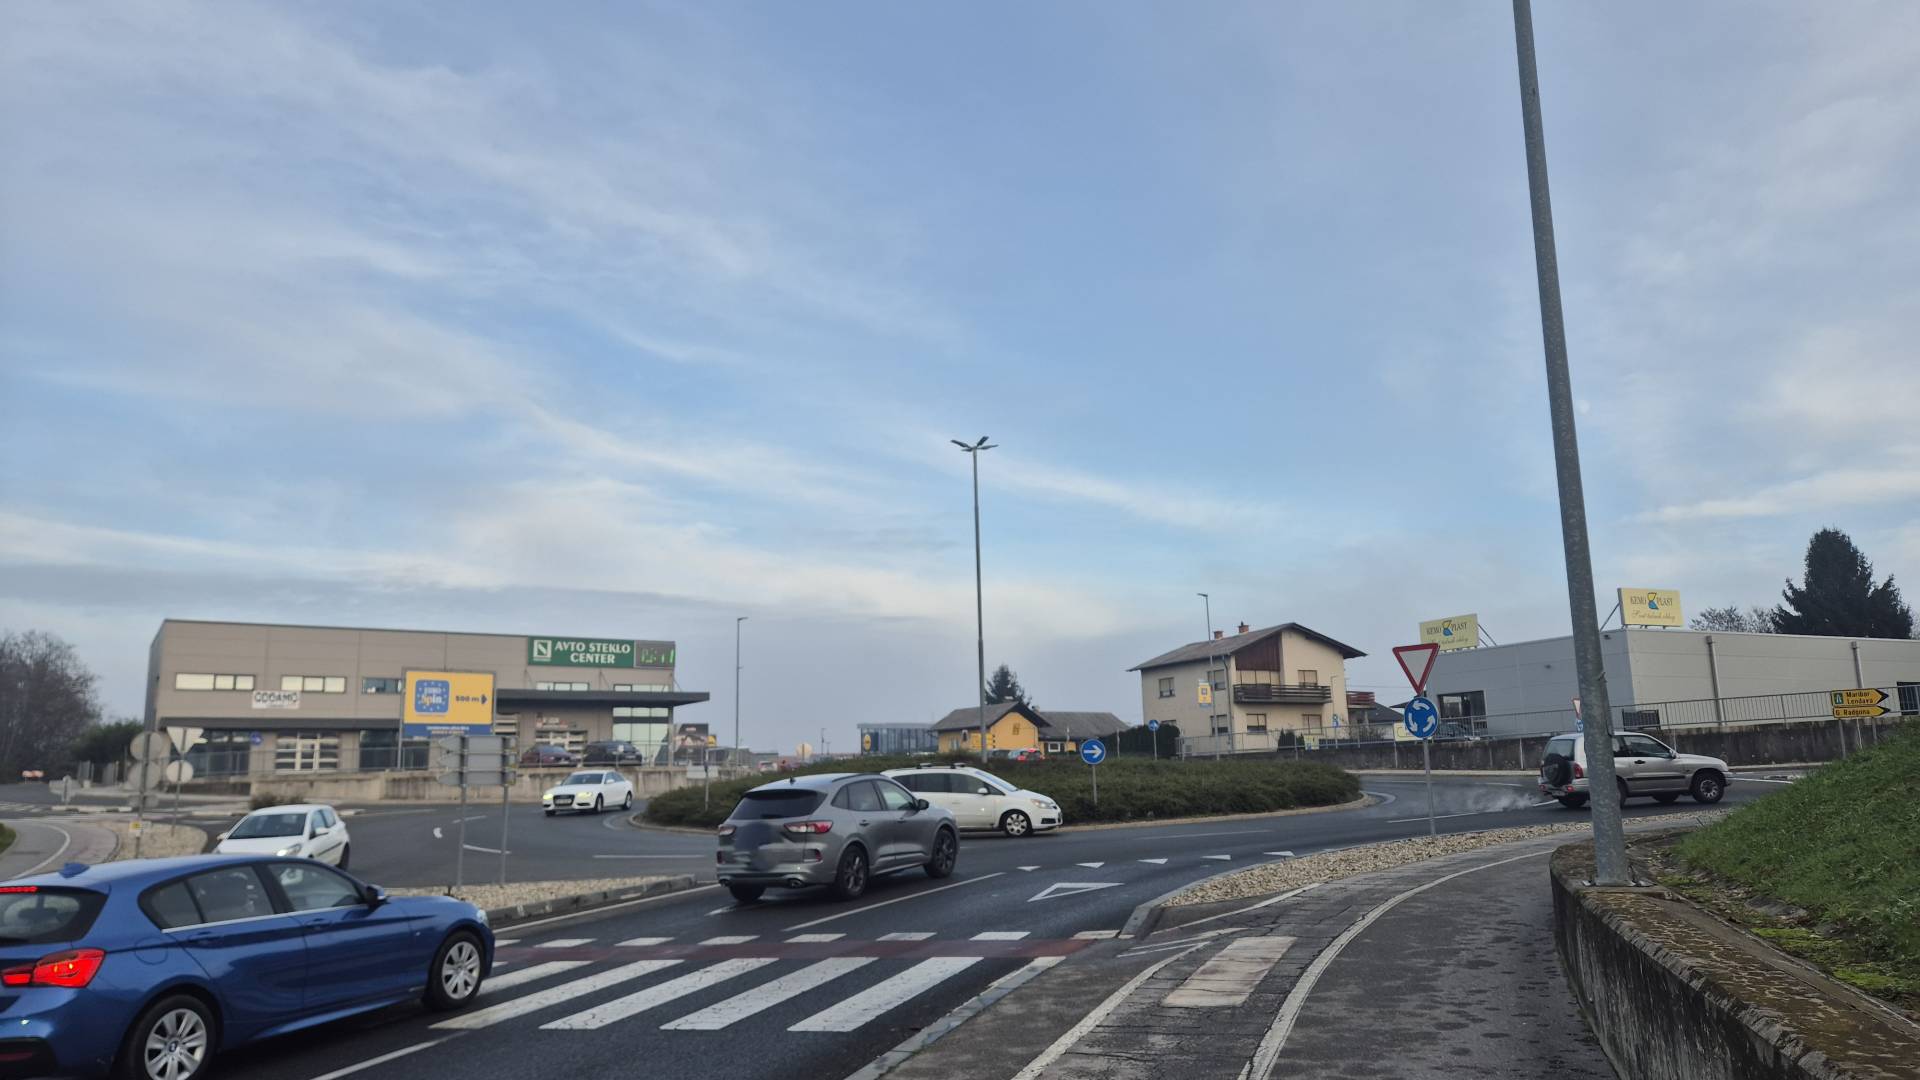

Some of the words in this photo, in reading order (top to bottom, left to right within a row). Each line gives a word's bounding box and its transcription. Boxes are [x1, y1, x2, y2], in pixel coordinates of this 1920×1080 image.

[554, 641, 586, 653] AVTO
[588, 642, 631, 654] STEKLO
[570, 652, 616, 664] CENTER
